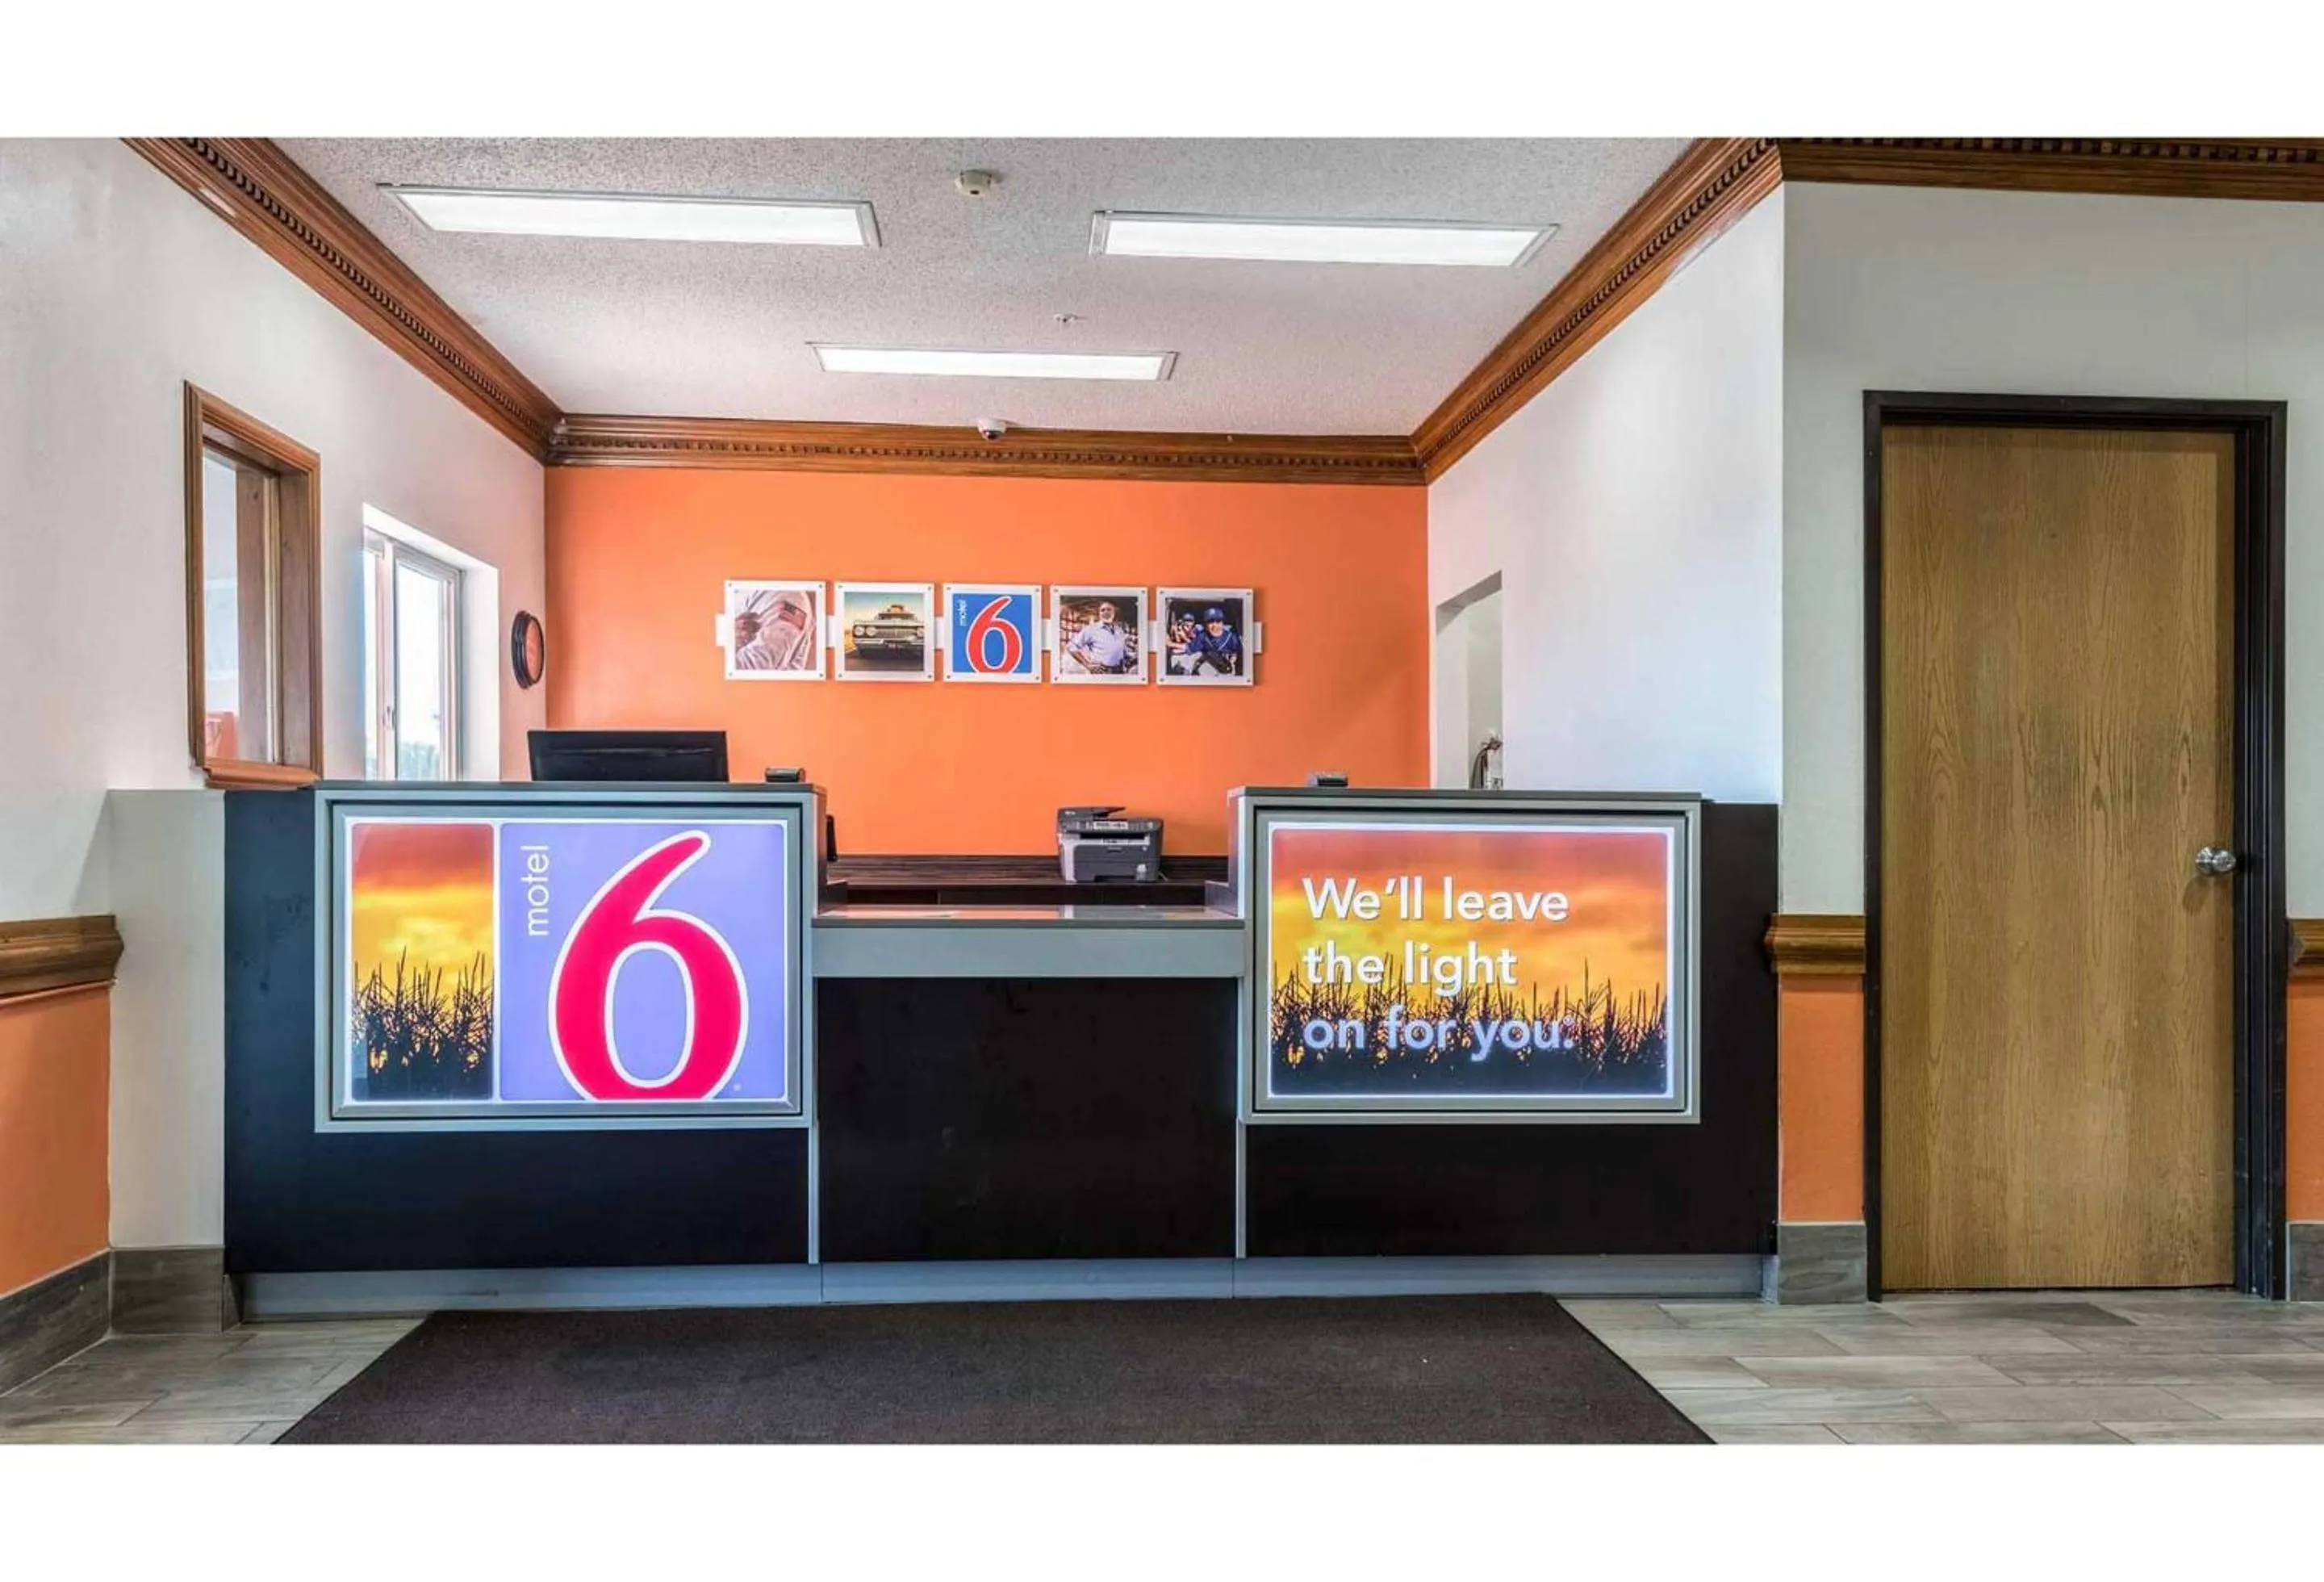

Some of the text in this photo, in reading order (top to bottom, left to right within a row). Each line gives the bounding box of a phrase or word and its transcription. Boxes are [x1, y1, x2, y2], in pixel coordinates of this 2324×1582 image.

[965, 596, 1023, 674] 6
[520, 844, 550, 937] motel
[1302, 876, 1570, 922] We'll leave
[548, 829, 750, 1102] 6
[1302, 940, 1519, 998] the light
[1302, 1016, 1365, 1050] on
[1386, 1004, 1460, 1050] for
